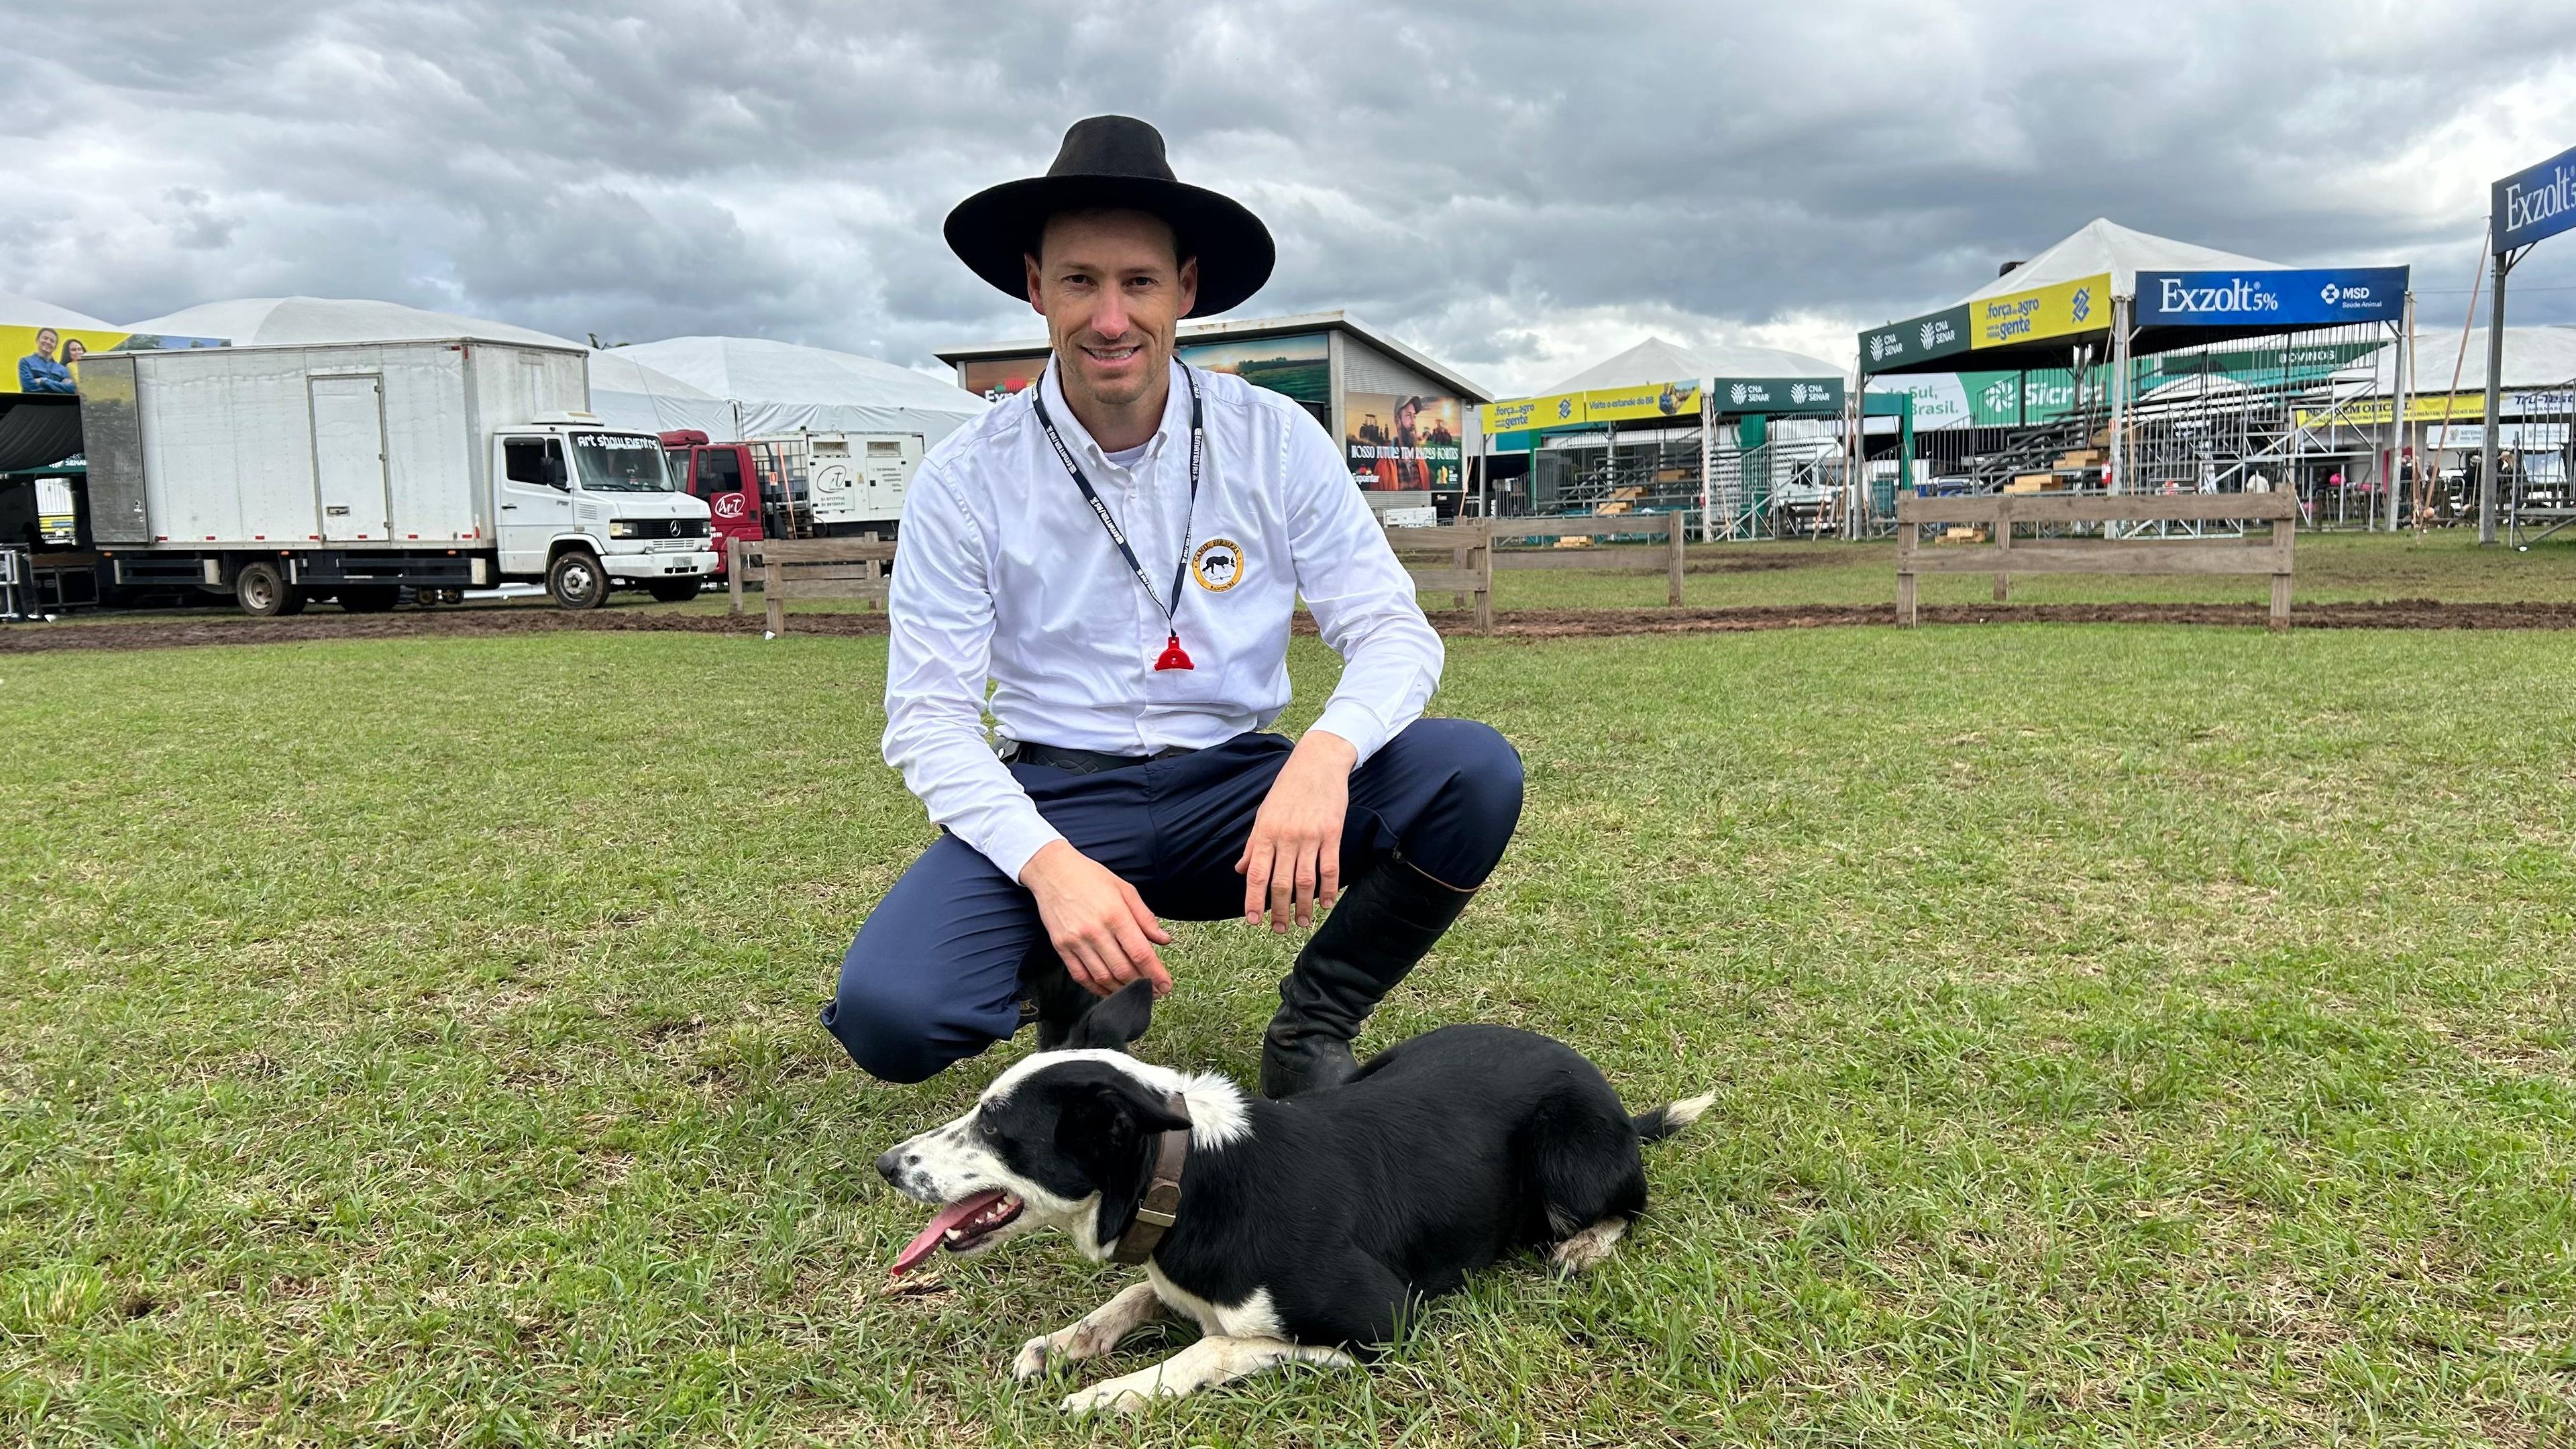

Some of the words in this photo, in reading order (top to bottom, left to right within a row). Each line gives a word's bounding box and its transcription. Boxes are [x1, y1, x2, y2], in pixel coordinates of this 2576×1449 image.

[2506, 166, 2570, 232] Exzolt
[2159, 278, 2253, 313] Exzolt
[2253, 292, 2278, 311] 5%
[2343, 287, 2370, 299] MSD
[1988, 302, 2011, 320] força
[2018, 299, 2039, 316] agro
[1935, 320, 1949, 333] CNA
[2000, 315, 2030, 341] gente
[1884, 333, 1897, 345] CNA
[1936, 329, 1955, 345] SENAR
[1885, 343, 1903, 356] SENAR
[1748, 385, 1763, 394] CNA
[1808, 384, 1823, 393] CNA
[1748, 393, 1770, 402] SENAR
[1808, 392, 1831, 402] SENAR
[1505, 415, 1528, 429] gente
[1351, 445, 1375, 459] NOSSO
[1401, 446, 1415, 460] TEM
